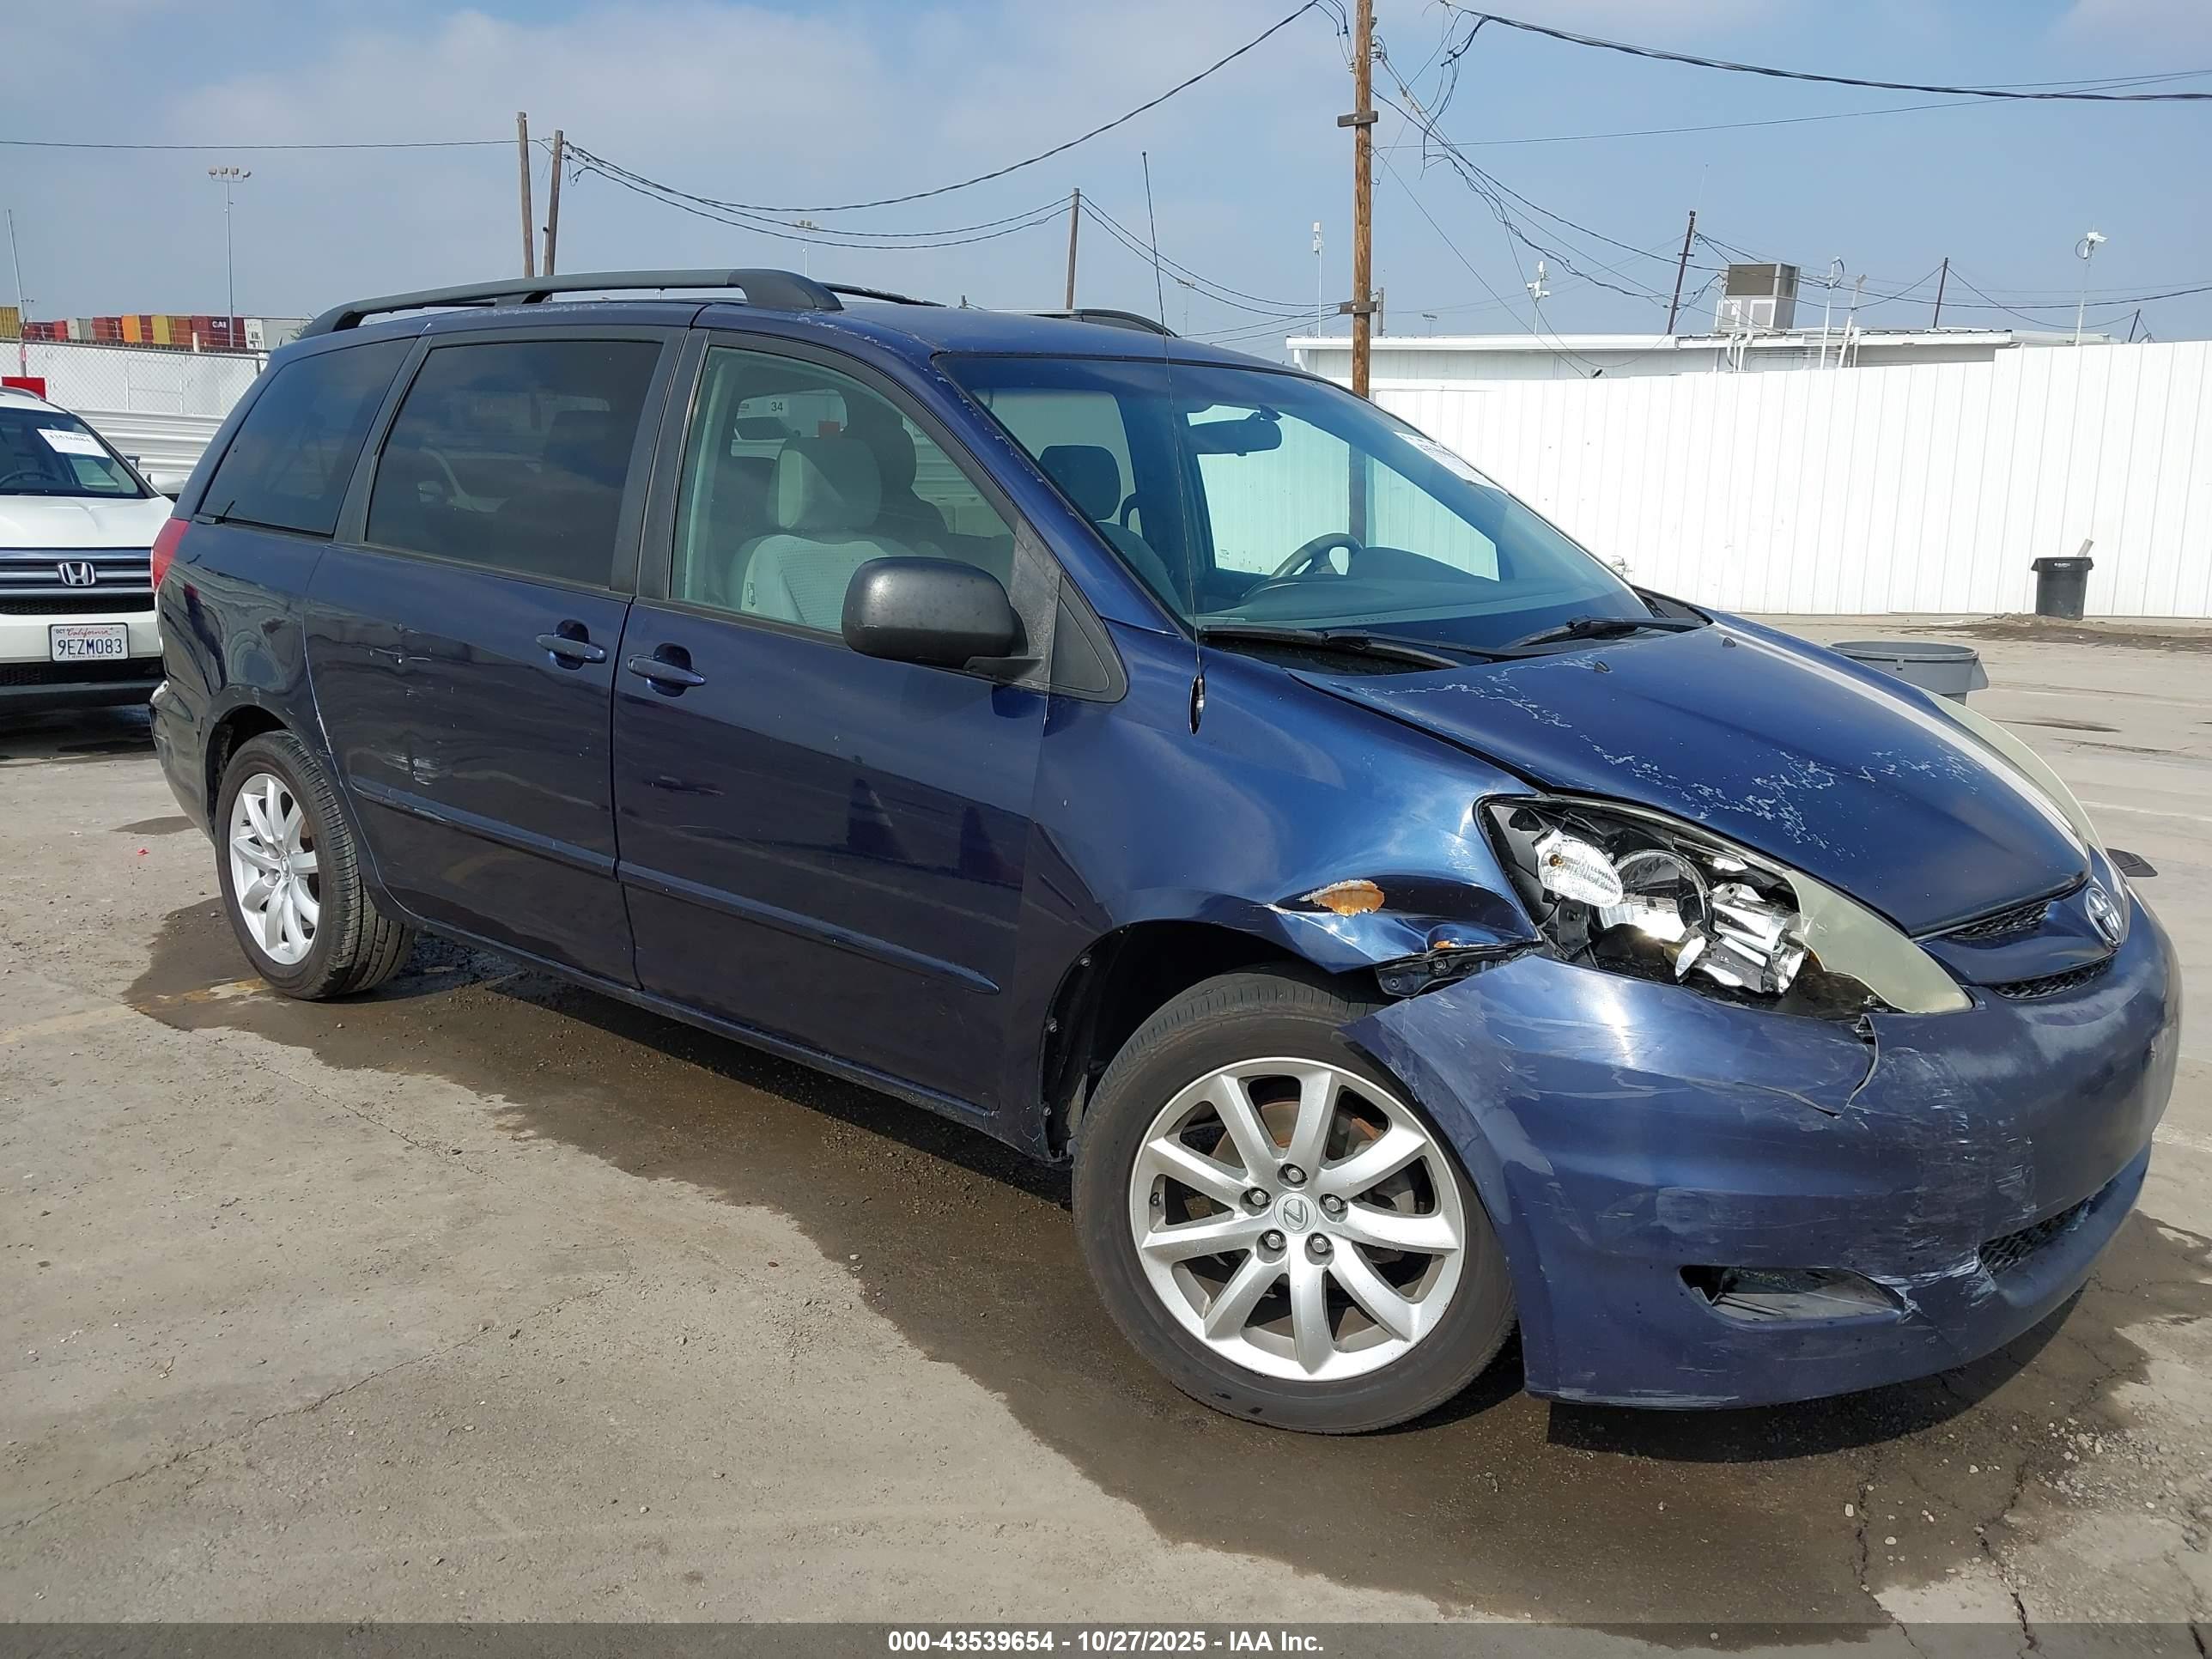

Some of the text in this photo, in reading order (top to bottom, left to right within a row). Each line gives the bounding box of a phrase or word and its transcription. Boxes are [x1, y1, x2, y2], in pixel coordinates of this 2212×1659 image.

[212, 320, 227, 329] CAI
[771, 402, 783, 412] 34
[68, 627, 111, 638] California
[58, 639, 123, 656] 9EZM083
